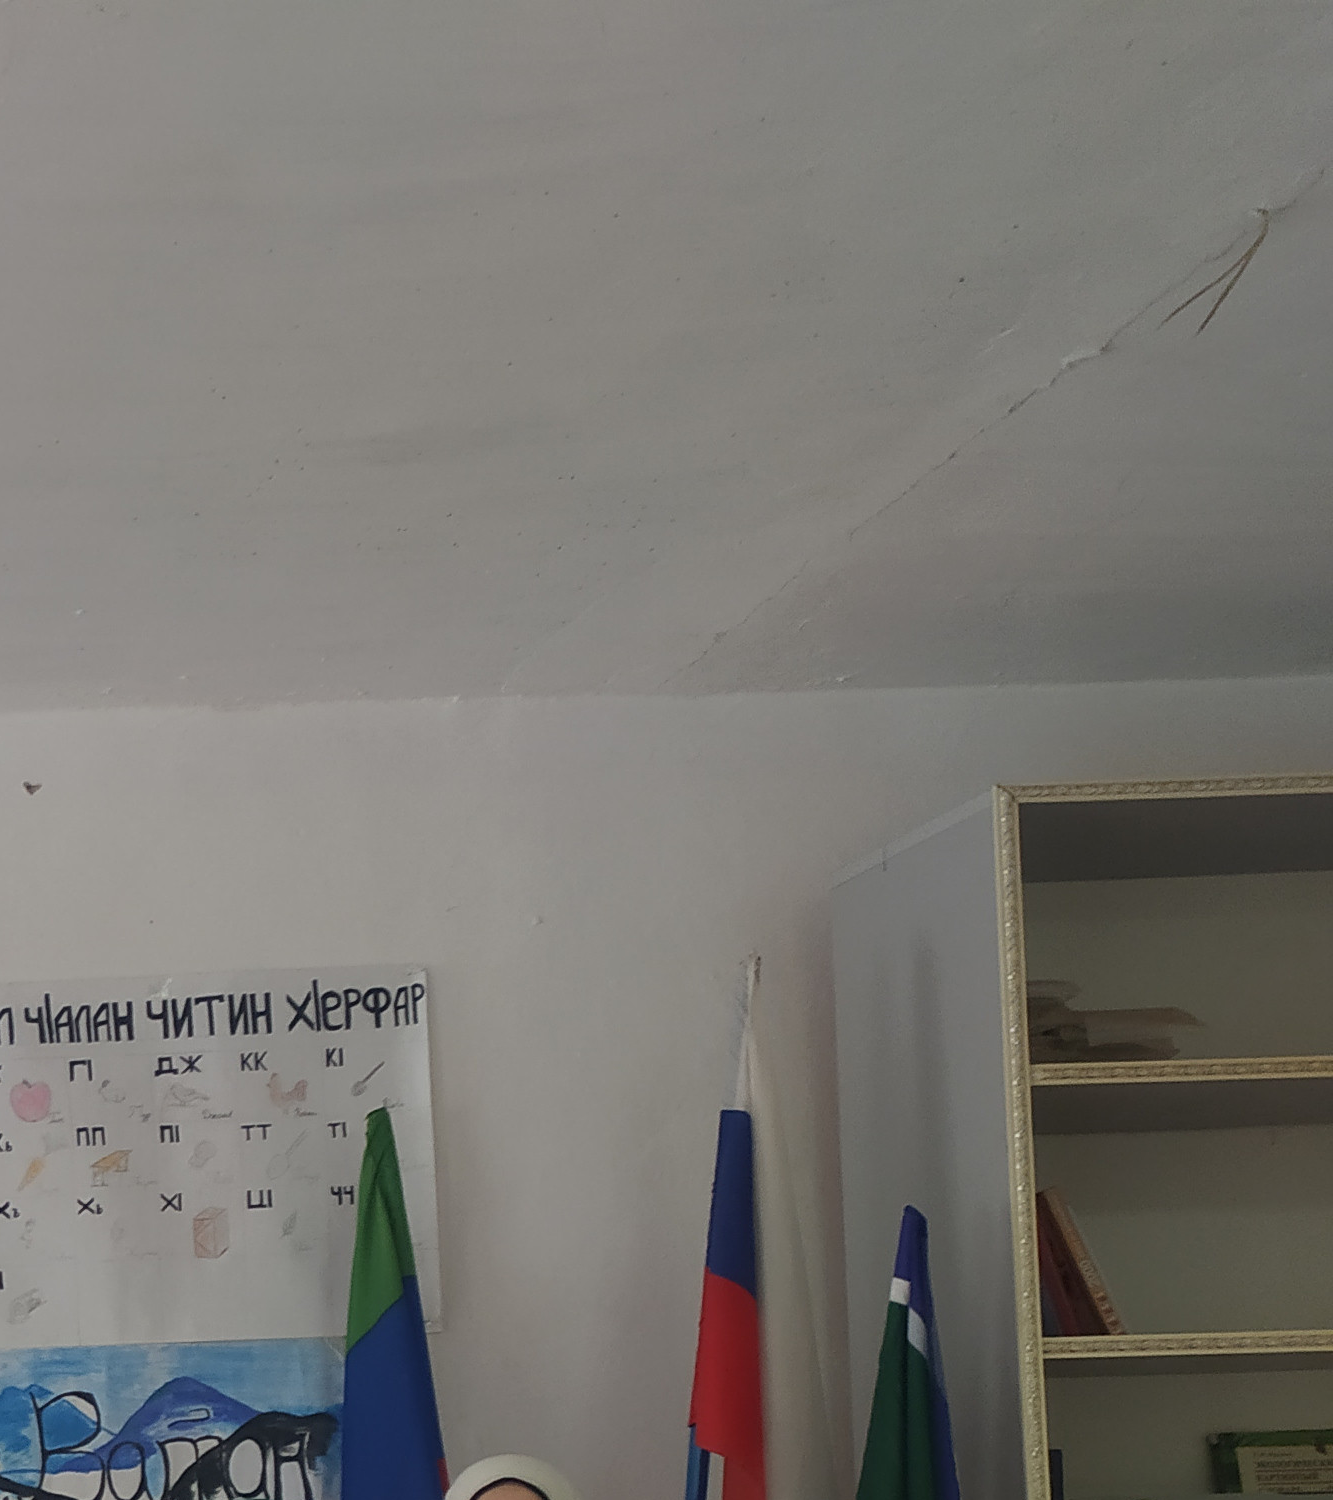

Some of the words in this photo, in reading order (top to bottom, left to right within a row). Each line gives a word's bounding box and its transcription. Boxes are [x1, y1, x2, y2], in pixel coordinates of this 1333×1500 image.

[146, 991, 272, 1038] ЧИТИН
[154, 1055, 204, 1077] ДЖ
[240, 1051, 268, 1072] КК
[76, 1127, 106, 1146] ПП
[241, 1124, 272, 1141] ТТ
[330, 1185, 355, 1206] ЧЧ
